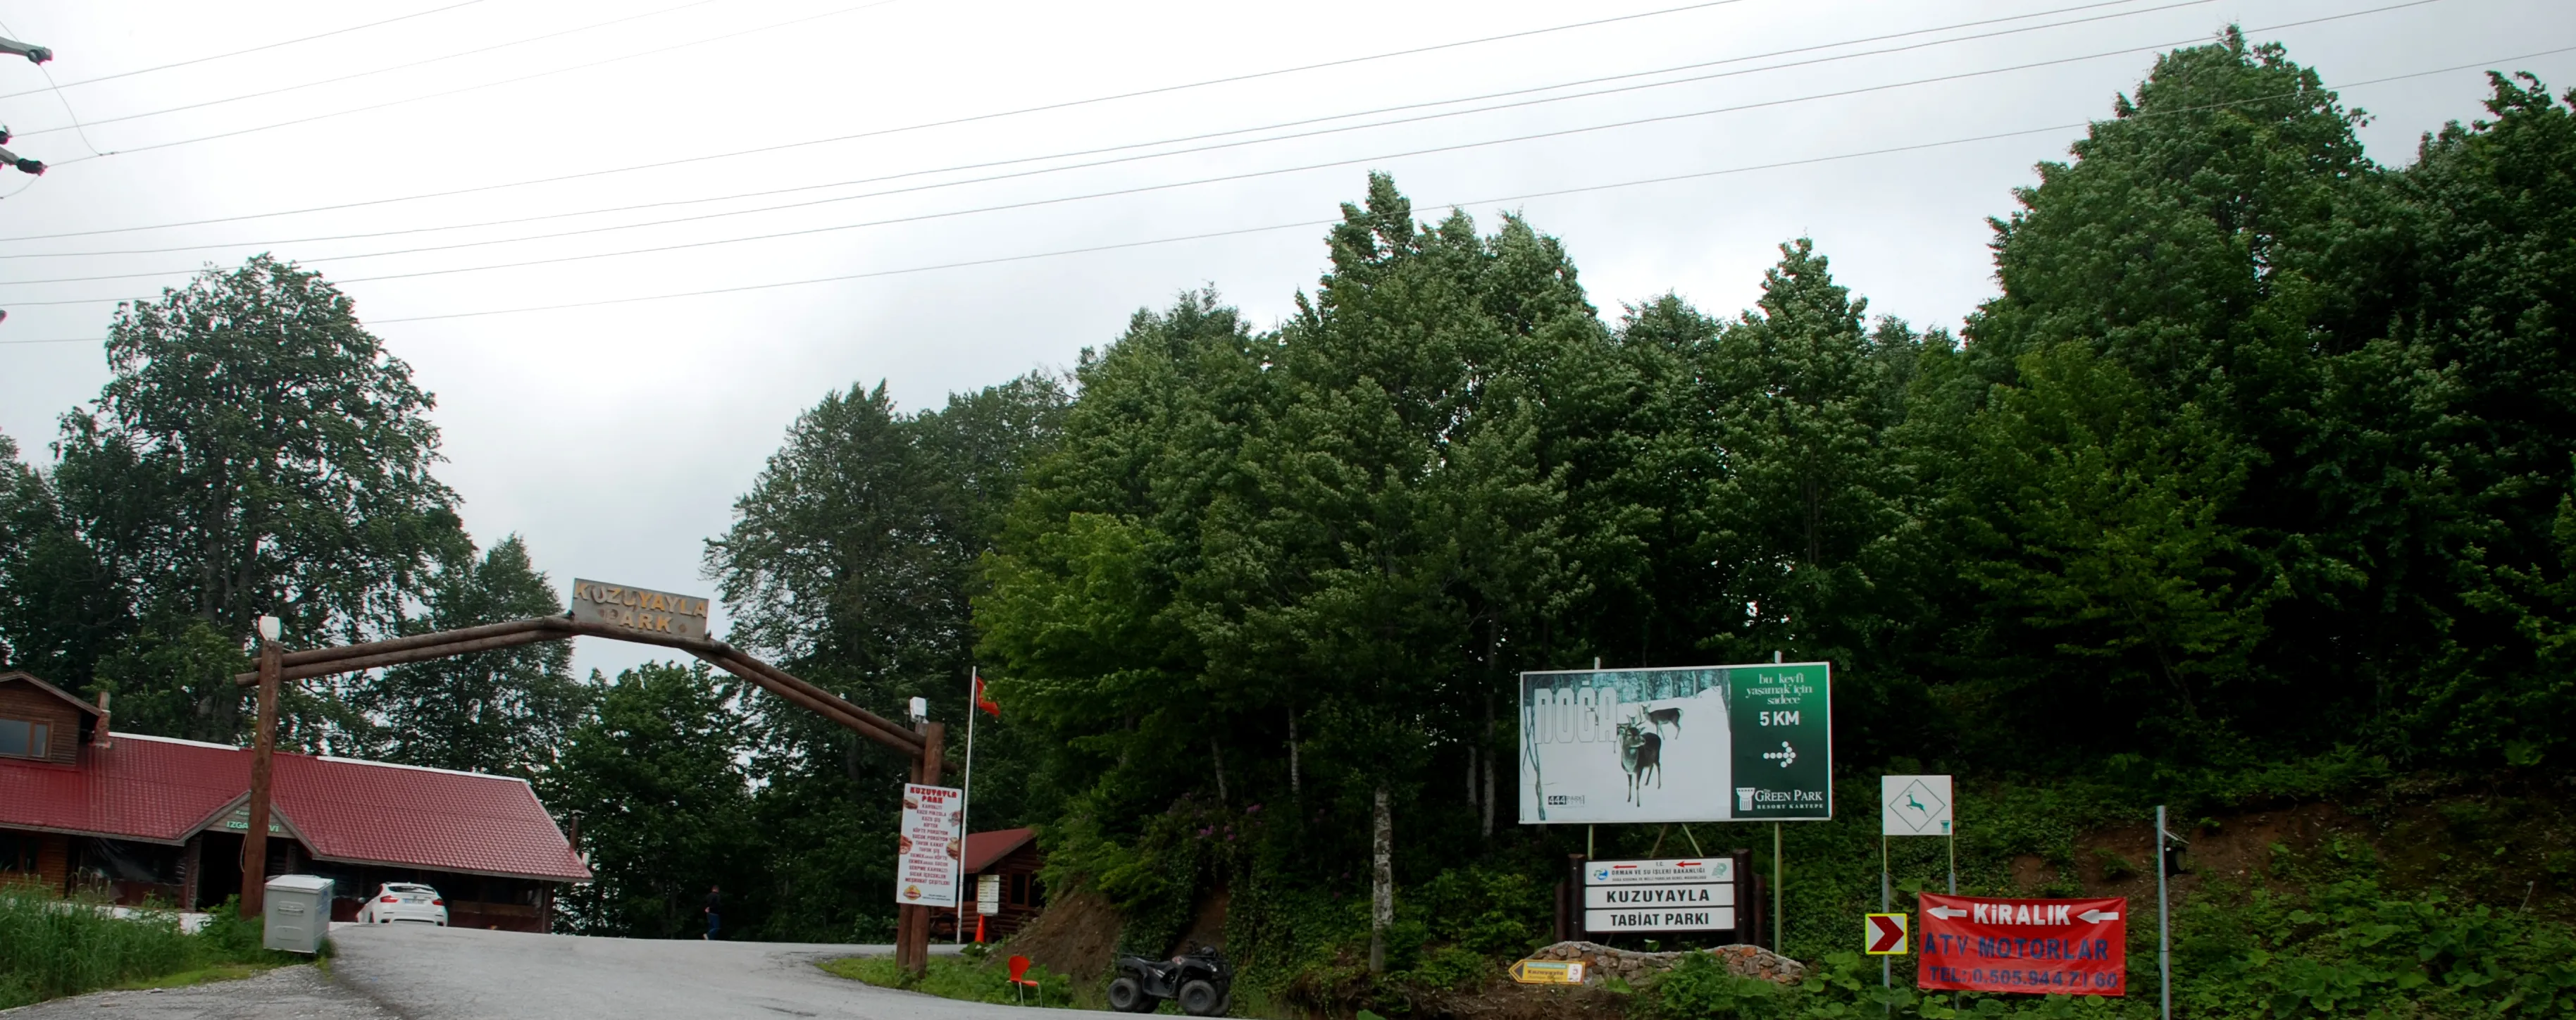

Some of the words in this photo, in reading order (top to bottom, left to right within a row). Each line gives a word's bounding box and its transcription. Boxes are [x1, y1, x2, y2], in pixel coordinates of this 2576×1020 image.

[573, 580, 707, 618] KUZUYAYLA
[604, 607, 672, 633] PARK
[1759, 673, 1772, 684] bu
[1779, 672, 1804, 687] keyfi
[1746, 684, 1791, 699] yaşamak
[1793, 685, 1812, 696] için
[1767, 695, 1801, 705] sadece
[1534, 680, 1617, 744] DOĞA
[1760, 711, 1769, 726] 5
[1773, 711, 1800, 726] KM
[910, 787, 957, 798] KUZUYAYLA
[922, 795, 943, 804] PARK
[1550, 796, 1565, 804] 444
[1755, 790, 1791, 802] GREEN
[1793, 789, 1823, 801] PARK
[1607, 889, 1710, 903] KUZUYAYLA
[1610, 912, 1660, 926] TABİAT
[1665, 912, 1709, 925] PARKI
[1923, 932, 1969, 956] ATV
[1978, 936, 2108, 960] MOTORLAR
[1929, 966, 1967, 982] TEL:
[1972, 969, 2062, 987] 0.505.944
[2095, 972, 2117, 988] 60
